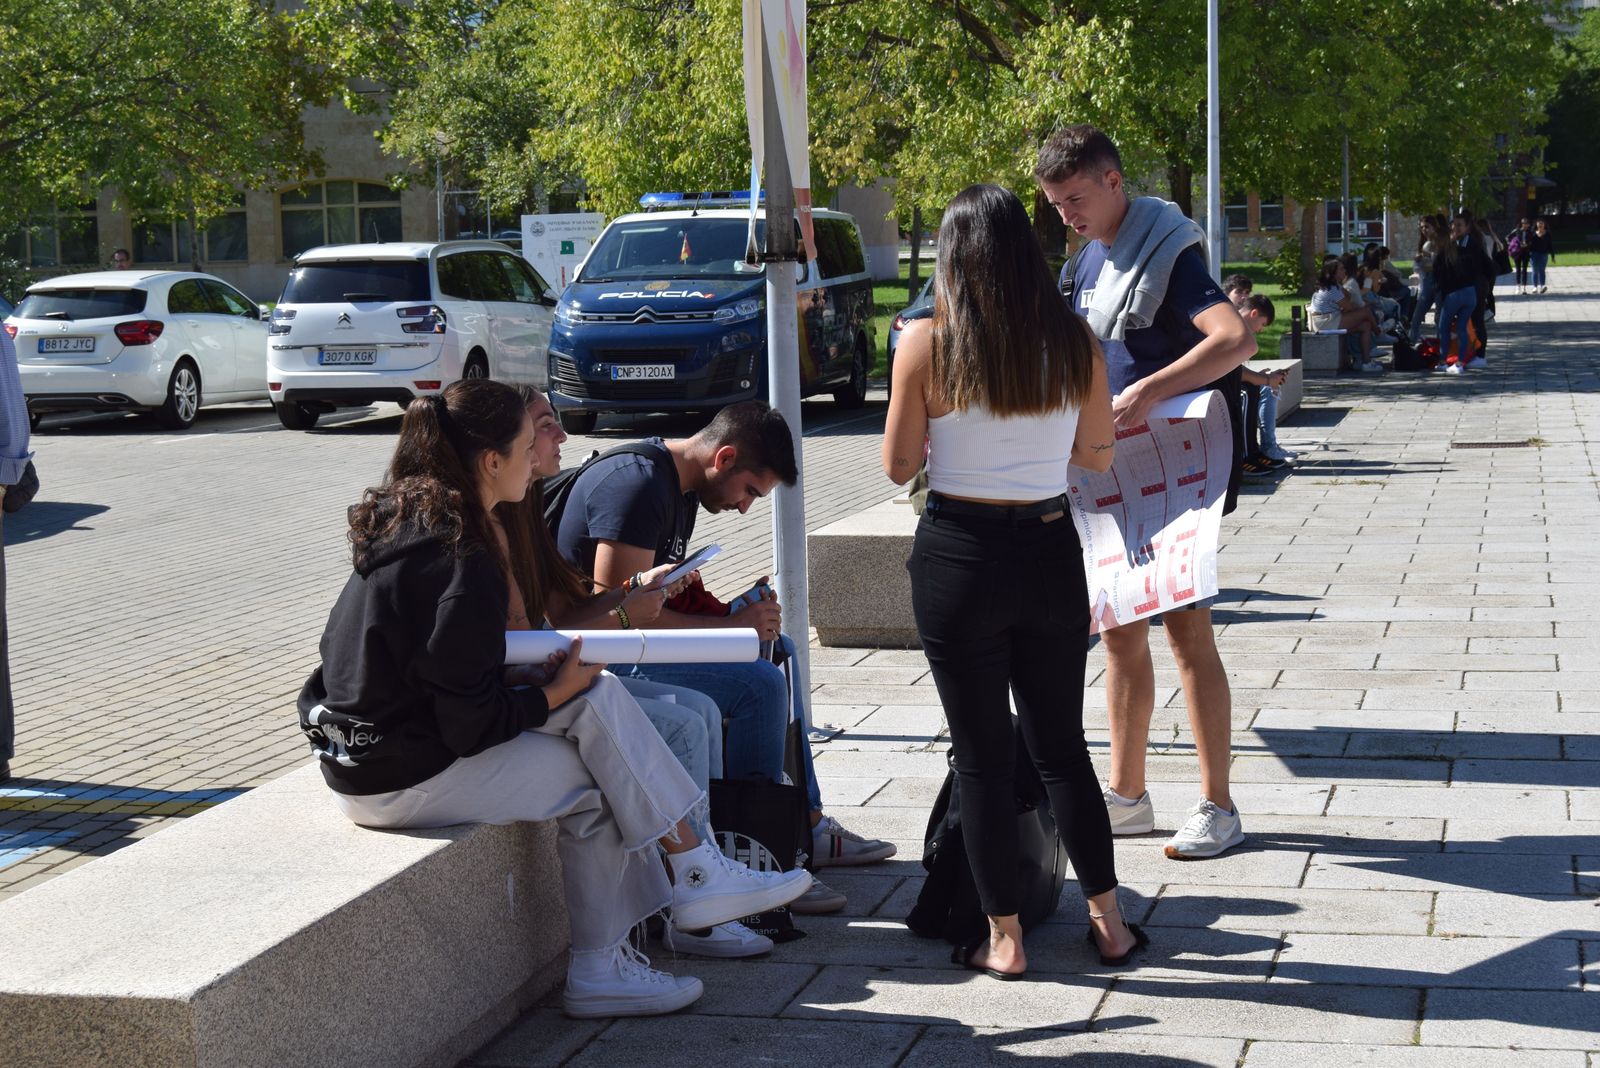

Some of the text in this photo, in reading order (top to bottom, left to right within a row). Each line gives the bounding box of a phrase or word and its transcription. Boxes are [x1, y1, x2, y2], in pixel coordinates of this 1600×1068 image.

[45, 338, 91, 350] 8812 JYC
[325, 351, 374, 362] 3070 KGK
